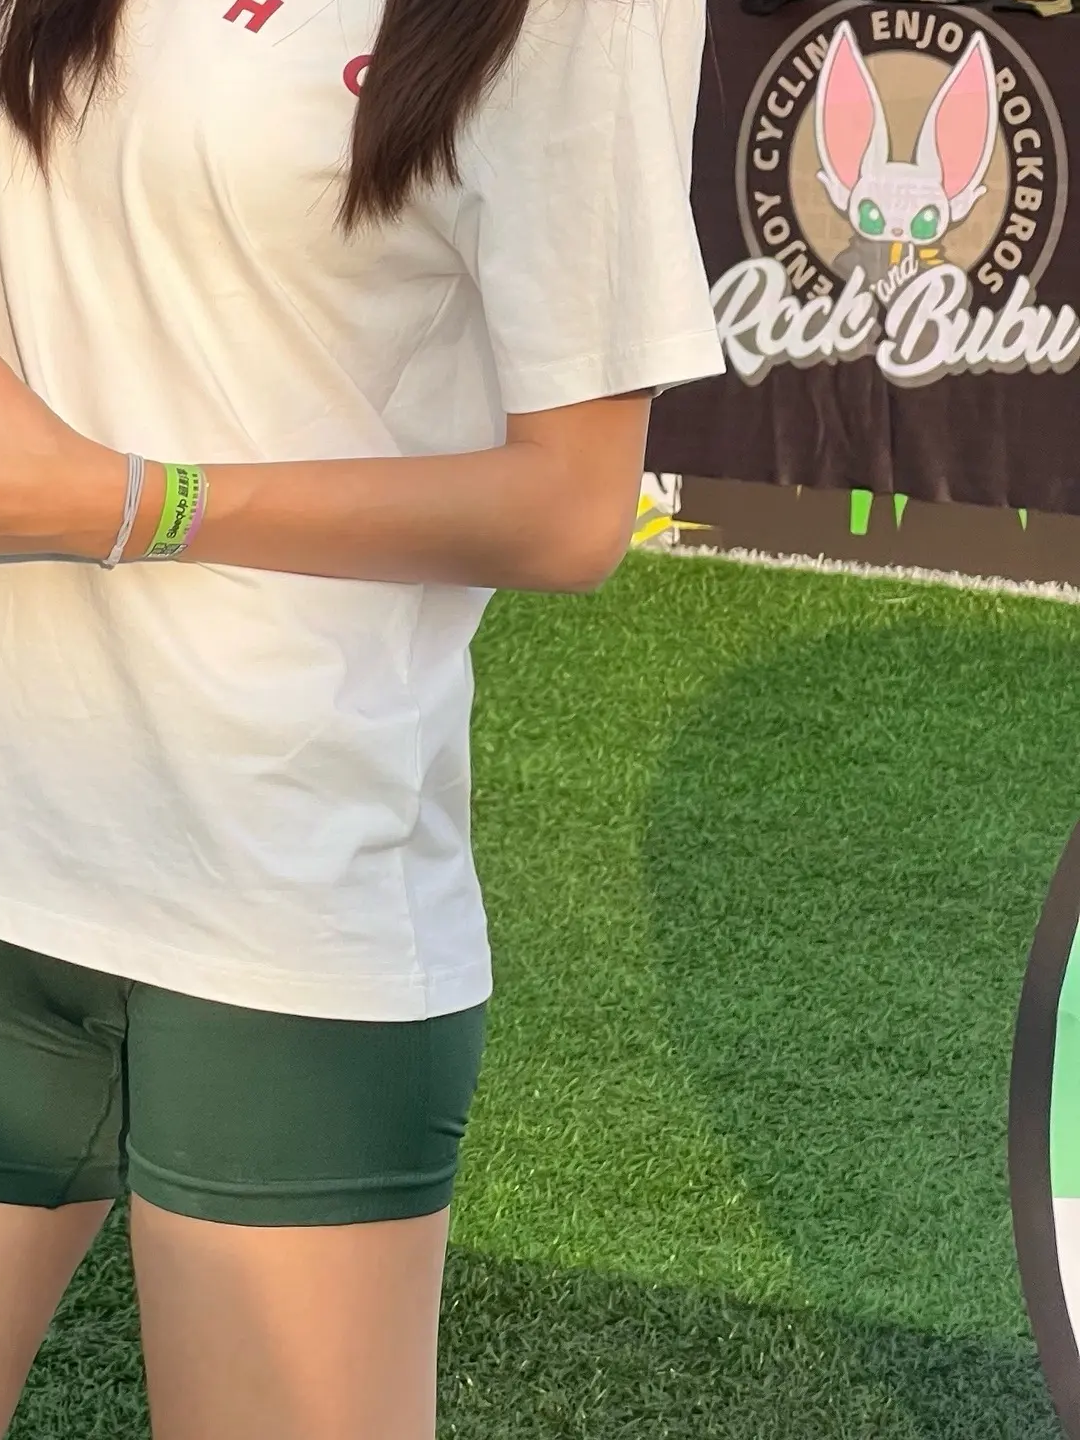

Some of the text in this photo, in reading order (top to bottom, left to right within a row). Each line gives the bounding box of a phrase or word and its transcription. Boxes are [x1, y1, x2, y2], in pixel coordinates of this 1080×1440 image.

[753, 34, 831, 171] CYCLIN
[870, 9, 964, 54] ENJO
[977, 67, 1045, 295] ROCKBROS
[710, 243, 1080, 380] Rock and Bubu
